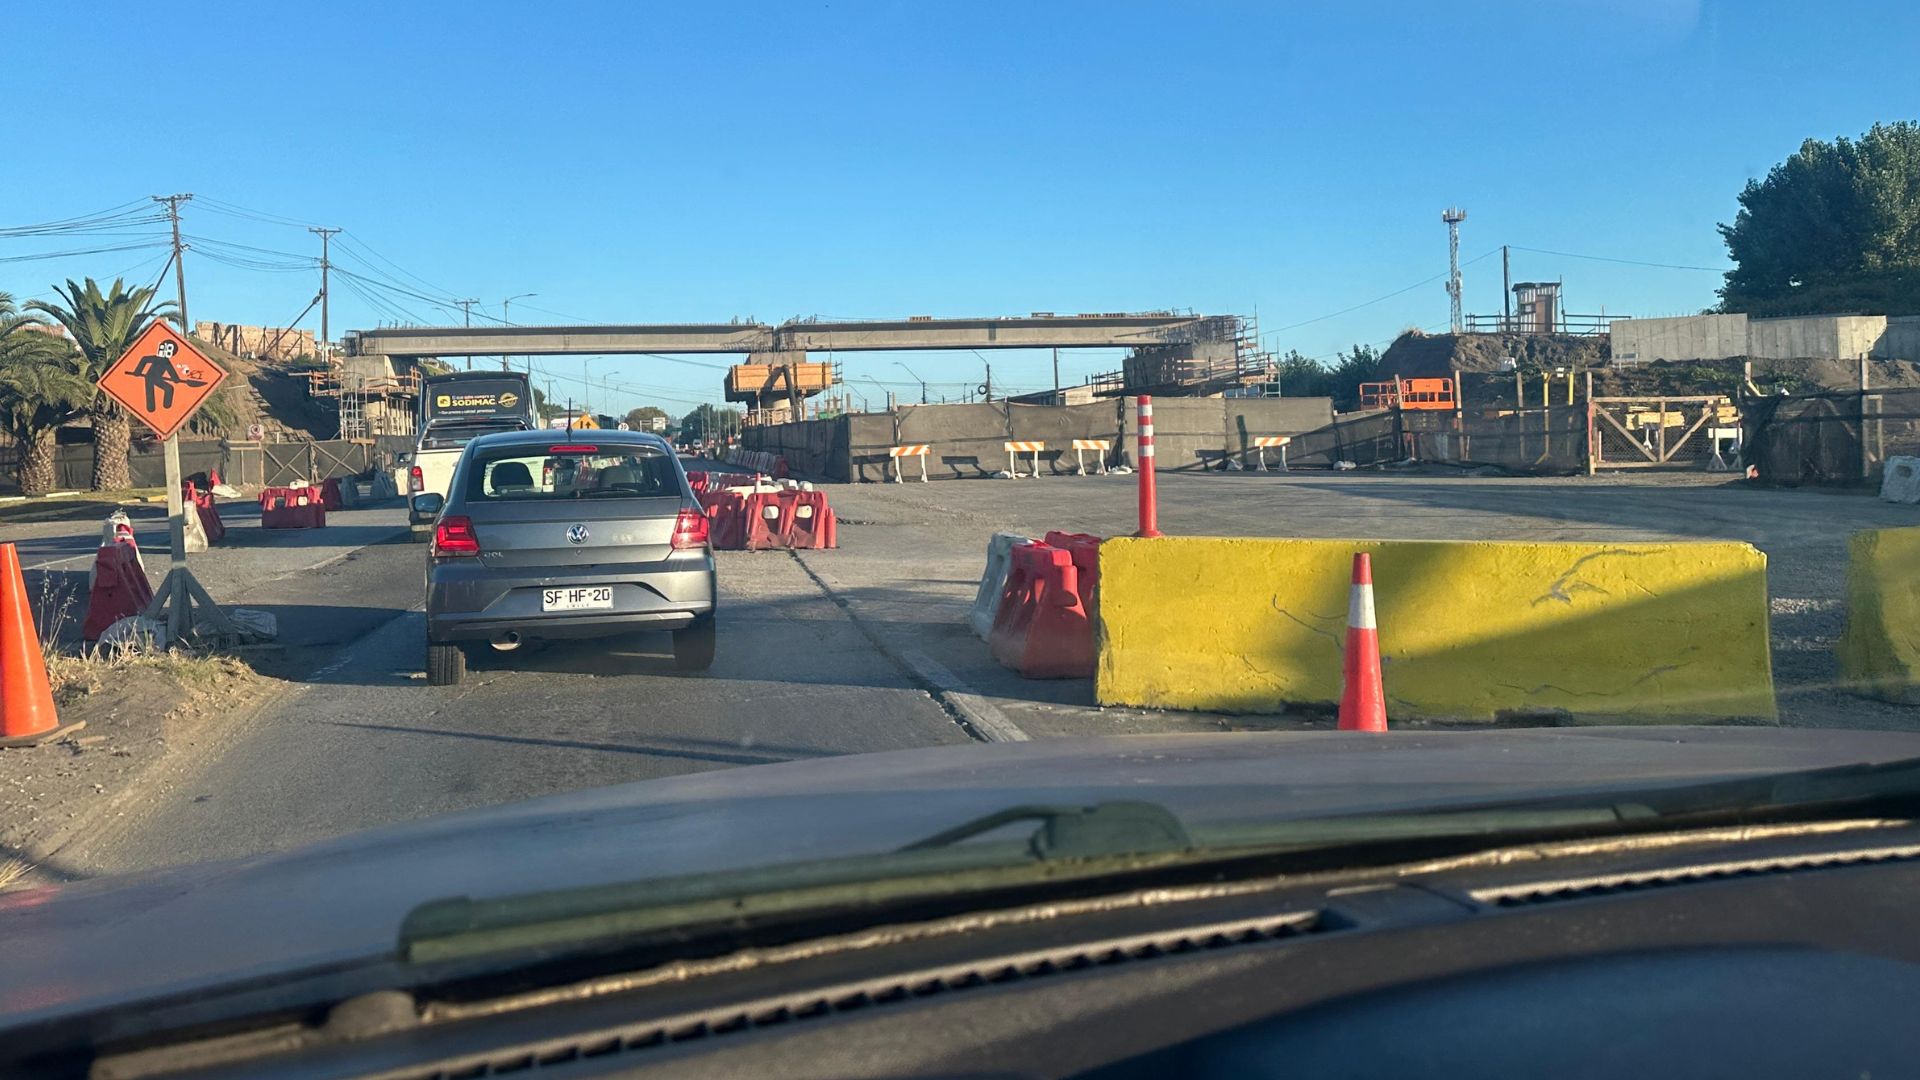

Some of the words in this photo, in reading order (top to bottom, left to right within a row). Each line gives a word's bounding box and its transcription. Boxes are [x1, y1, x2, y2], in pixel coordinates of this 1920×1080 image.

[452, 399, 496, 407] SODIMAC
[545, 590, 563, 604] SF
[569, 589, 587, 603] HF
[593, 588, 610, 601] 20
